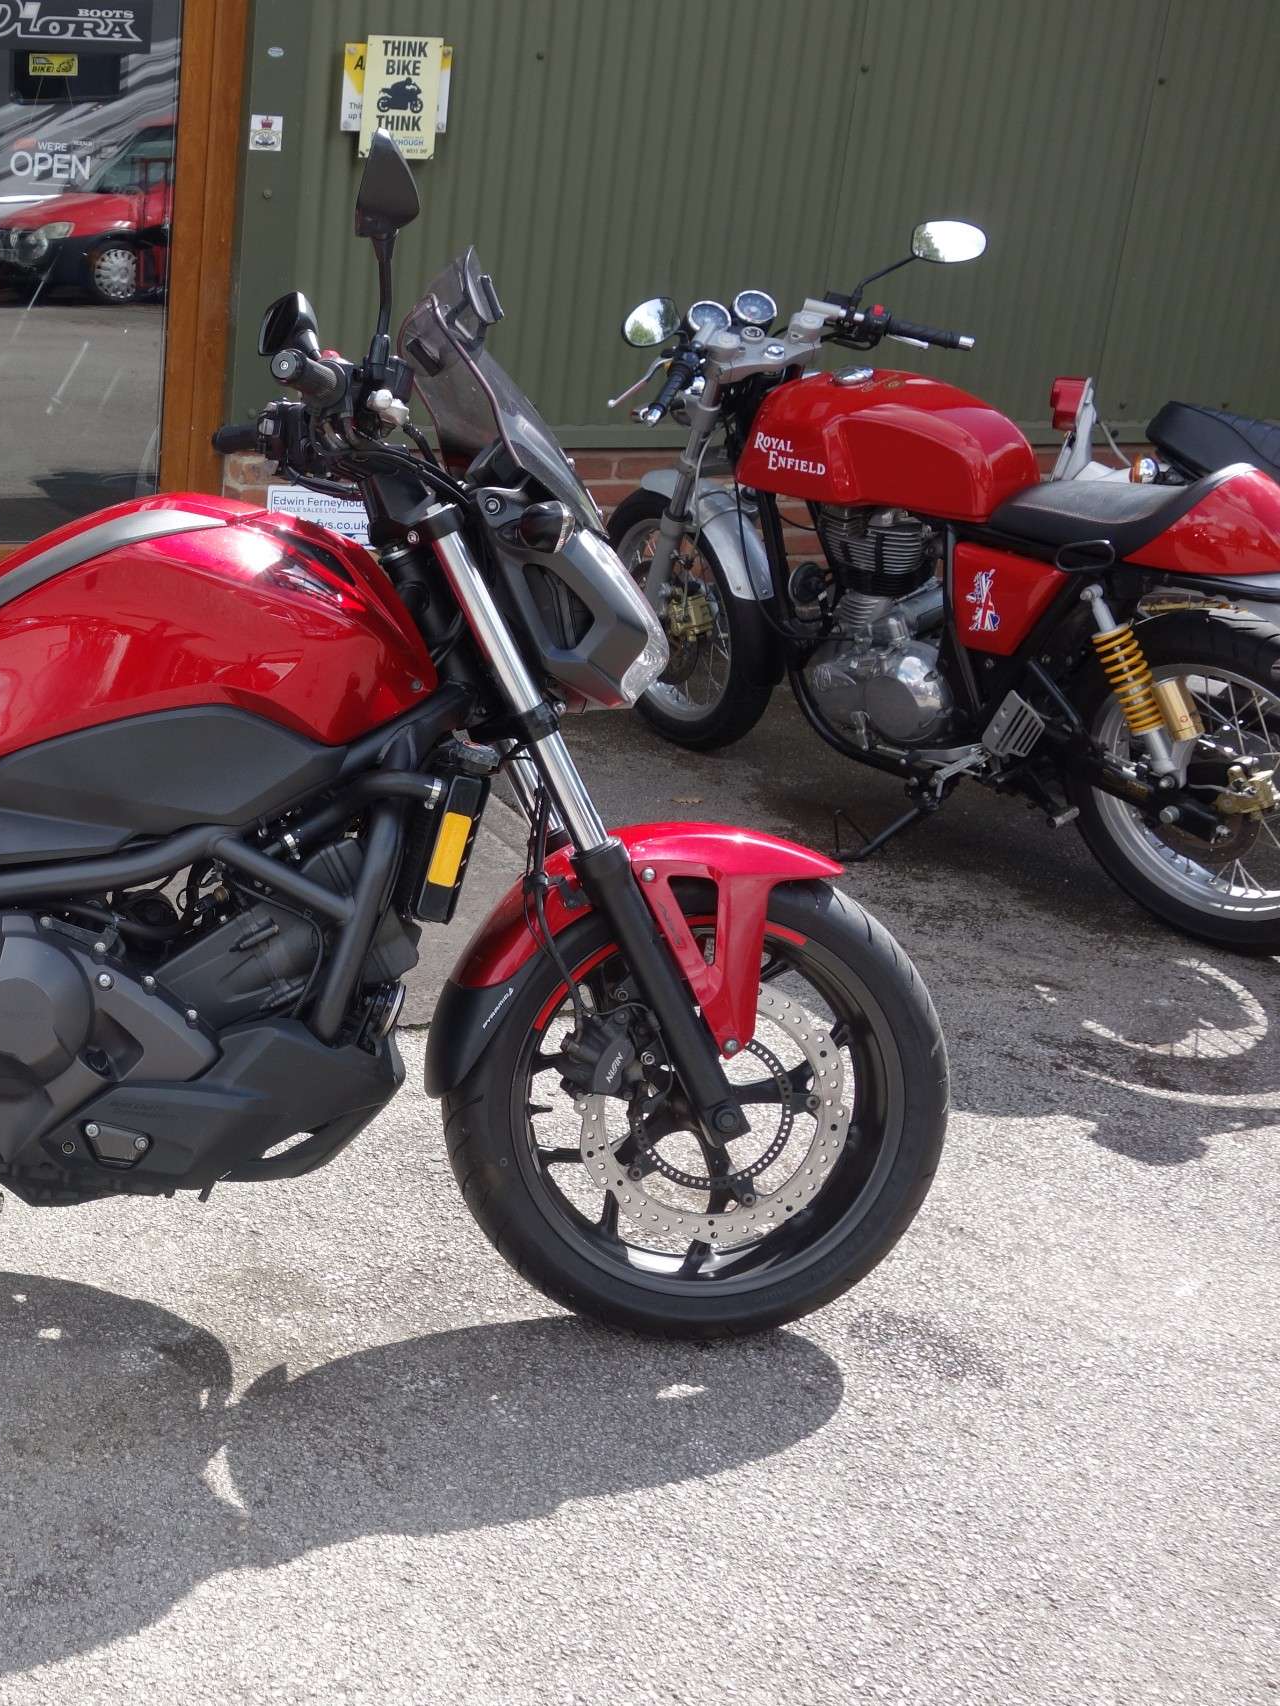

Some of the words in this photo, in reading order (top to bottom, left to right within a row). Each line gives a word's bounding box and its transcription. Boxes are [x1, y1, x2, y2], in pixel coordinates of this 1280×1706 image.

[77, 8, 135, 20] BOOTS
[382, 40, 429, 58] THINK
[354, 55, 366, 71] A
[385, 59, 421, 76] BIKE
[375, 114, 422, 132] THINK
[10, 152, 92, 180] OPEN
[754, 431, 794, 453] ROYAL
[768, 450, 826, 476] ENFIELD
[273, 496, 305, 506] Edwin
